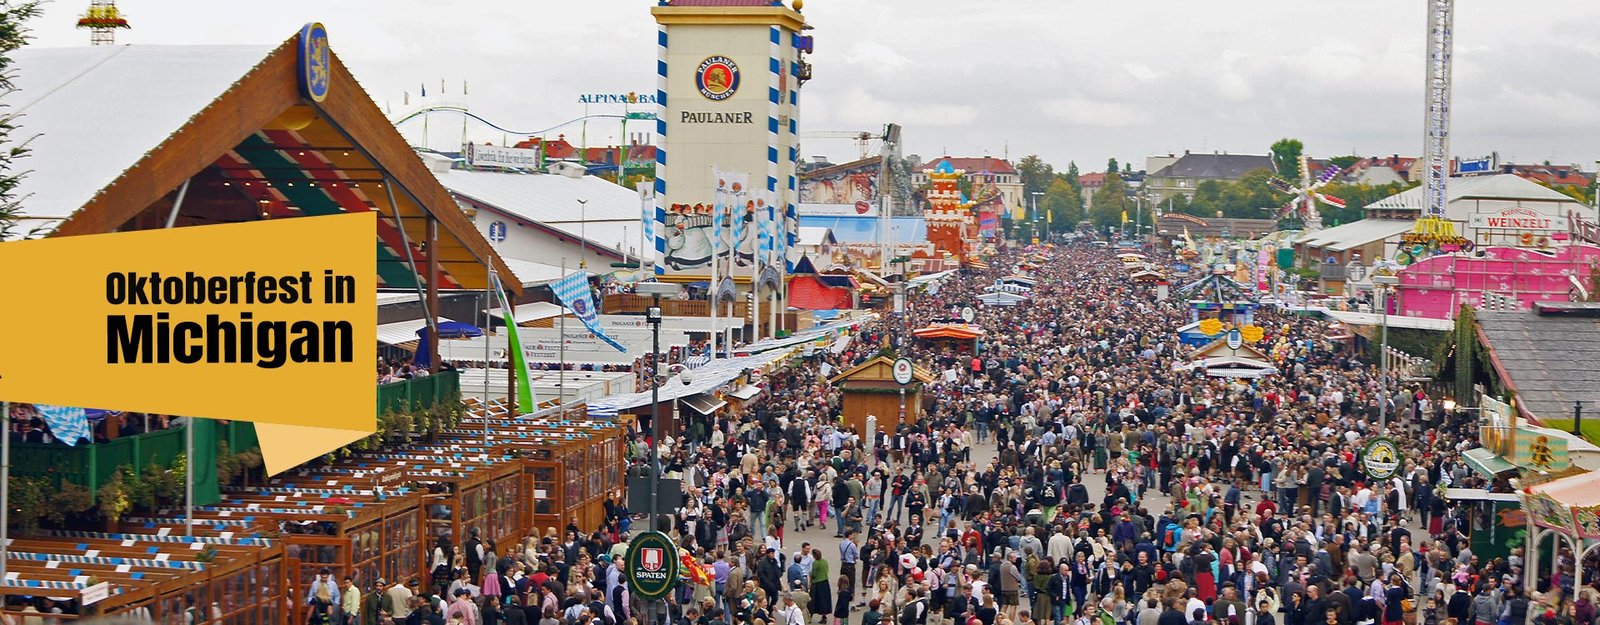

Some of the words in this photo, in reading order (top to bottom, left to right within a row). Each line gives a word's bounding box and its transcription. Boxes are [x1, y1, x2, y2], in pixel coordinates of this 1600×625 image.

[698, 57, 737, 73] PAULANER
[578, 94, 627, 103] ALPINA
[701, 89, 735, 100] MÜNCHEN
[680, 111, 753, 124] PAULANER
[1487, 217, 1551, 229] WEINZELT
[636, 571, 667, 579] SPATEN
